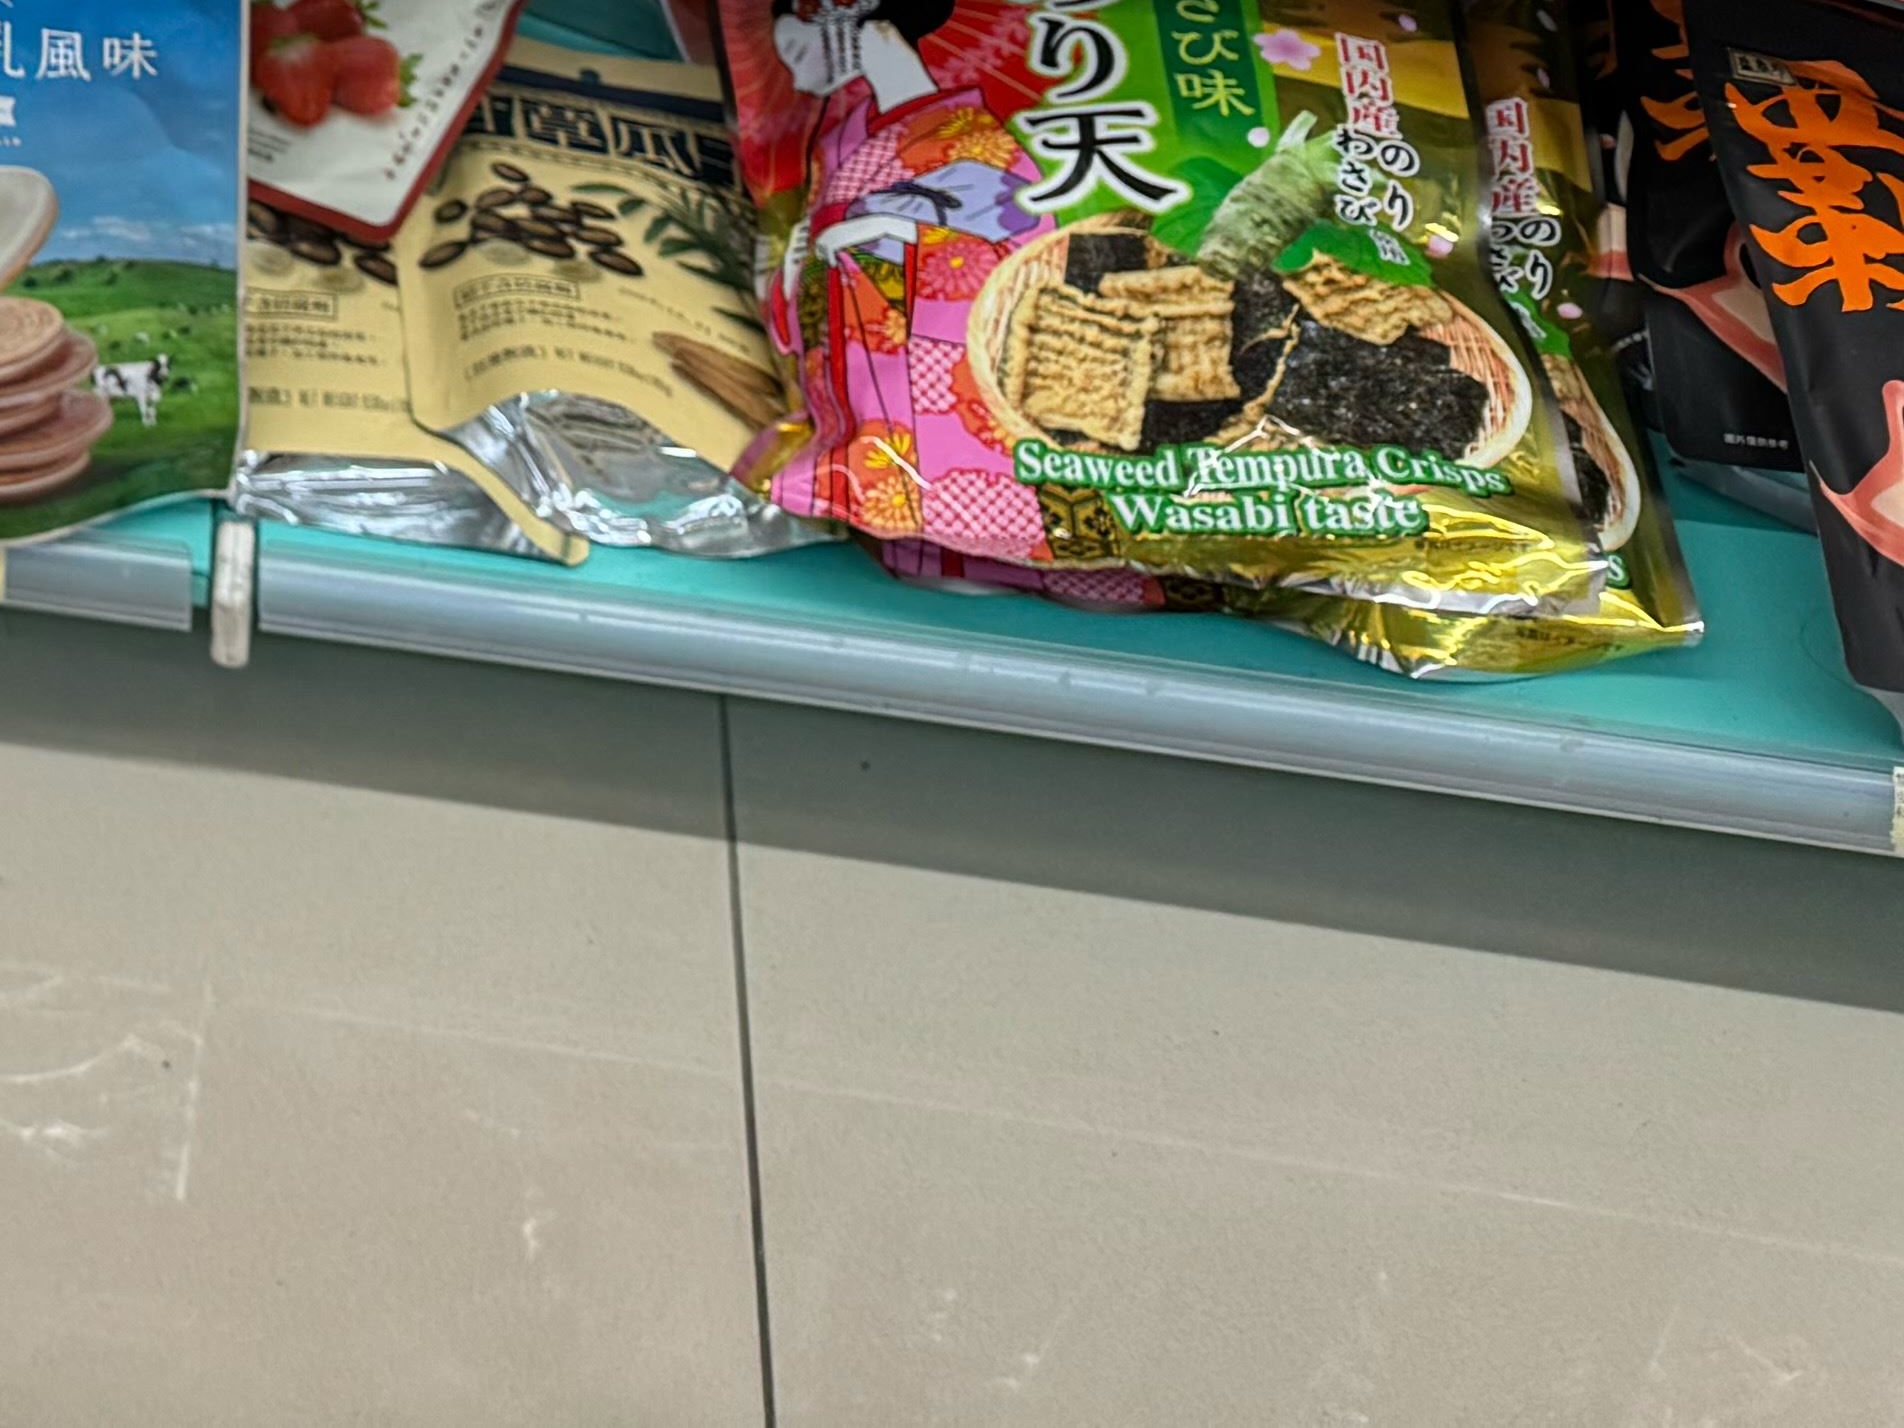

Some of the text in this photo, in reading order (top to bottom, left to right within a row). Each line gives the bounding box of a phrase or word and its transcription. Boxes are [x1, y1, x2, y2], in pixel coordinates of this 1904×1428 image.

[1335, 33, 1400, 134] 国内産
[1015, 440, 1513, 500] Seaweed Tempura Crisps
[1108, 490, 1425, 536] Wasabi taste
